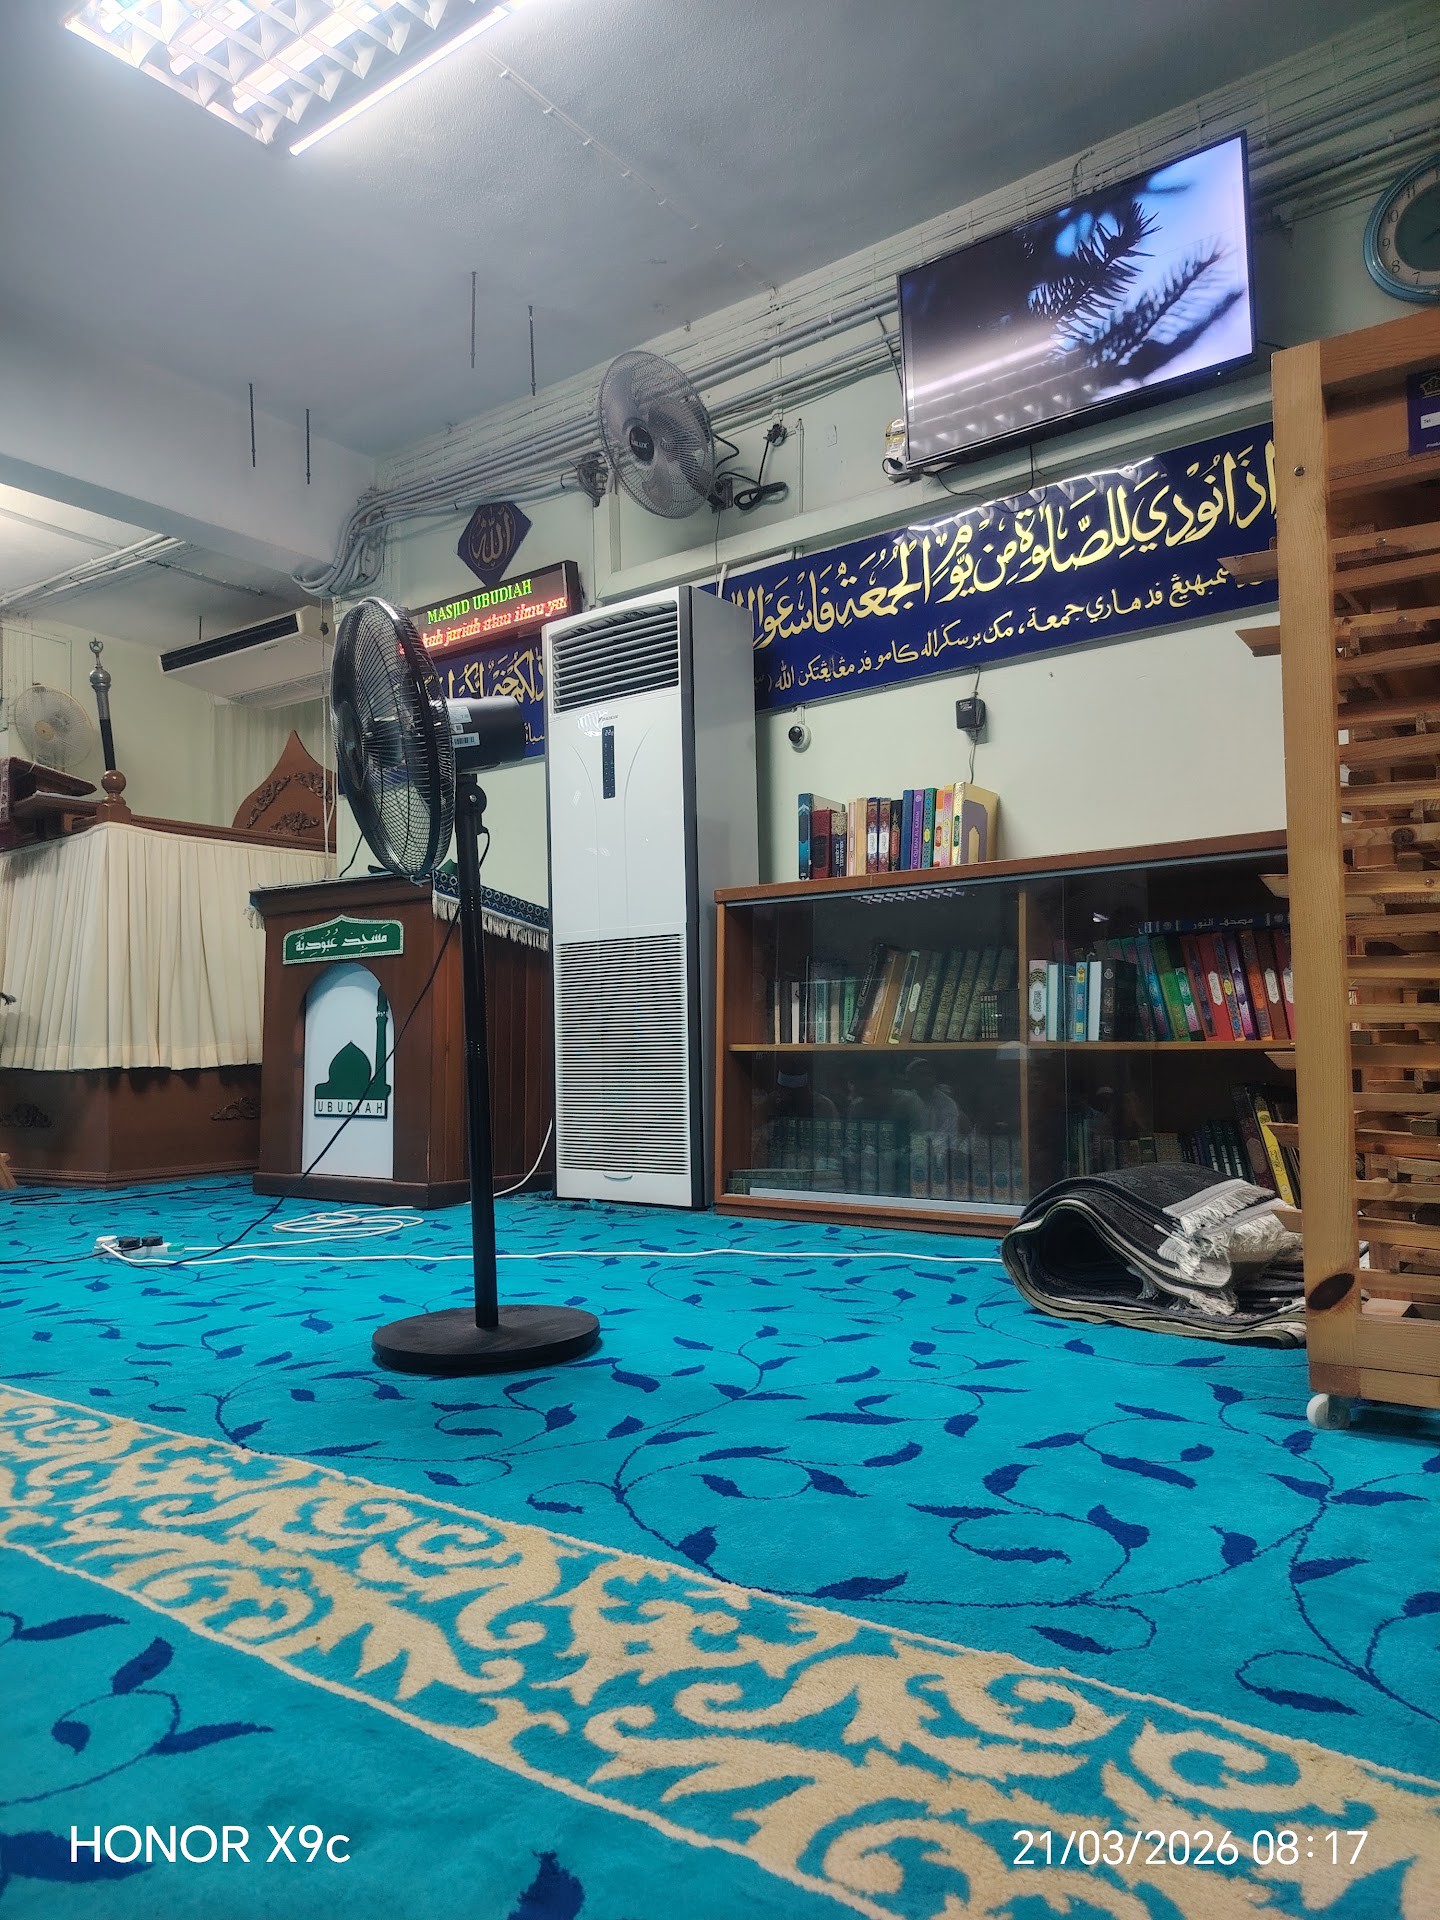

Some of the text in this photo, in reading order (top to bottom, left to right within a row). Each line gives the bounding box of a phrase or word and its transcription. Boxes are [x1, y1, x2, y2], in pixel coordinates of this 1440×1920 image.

[1406, 185, 1416, 199] 11
[1387, 209, 1399, 224] 10
[1382, 237, 1391, 251] 9
[1391, 260, 1401, 274] 8
[1411, 271, 1421, 285] 7
[427, 578, 533, 625] MASJID UBUDIAH
[444, 617, 481, 647] jariah
[483, 613, 512, 632] atau
[514, 603, 545, 622] ilmu
